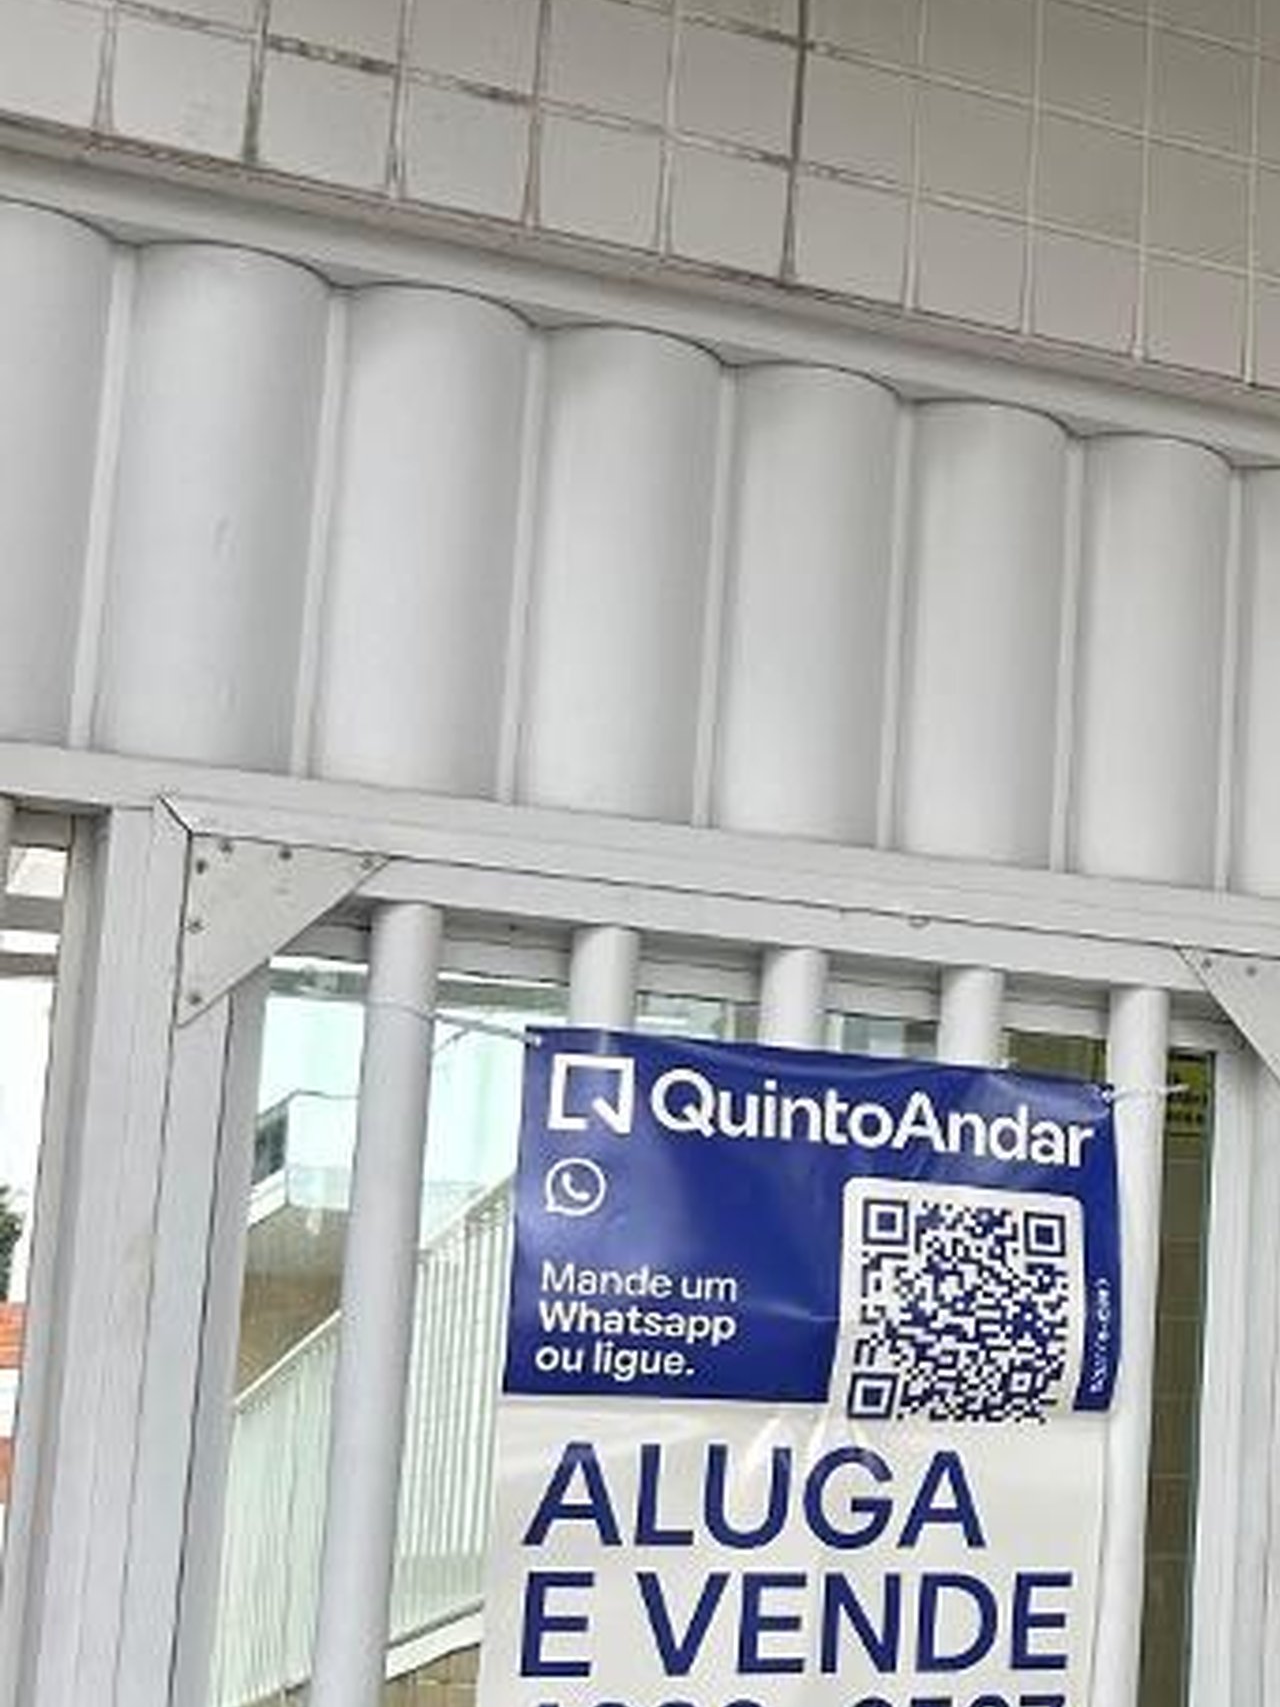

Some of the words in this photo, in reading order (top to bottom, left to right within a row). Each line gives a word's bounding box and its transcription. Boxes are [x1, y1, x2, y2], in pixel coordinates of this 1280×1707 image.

[650, 1068, 1093, 1167] QuintoAndar
[542, 1261, 673, 1300] Mande
[682, 1273, 737, 1301] um
[539, 1301, 736, 1346] Whatsapp
[536, 1348, 587, 1374] ou
[592, 1341, 695, 1380] ligue.
[521, 1441, 986, 1550] ALUGA
[518, 1570, 595, 1678] E
[636, 1570, 1073, 1677] VENDE
